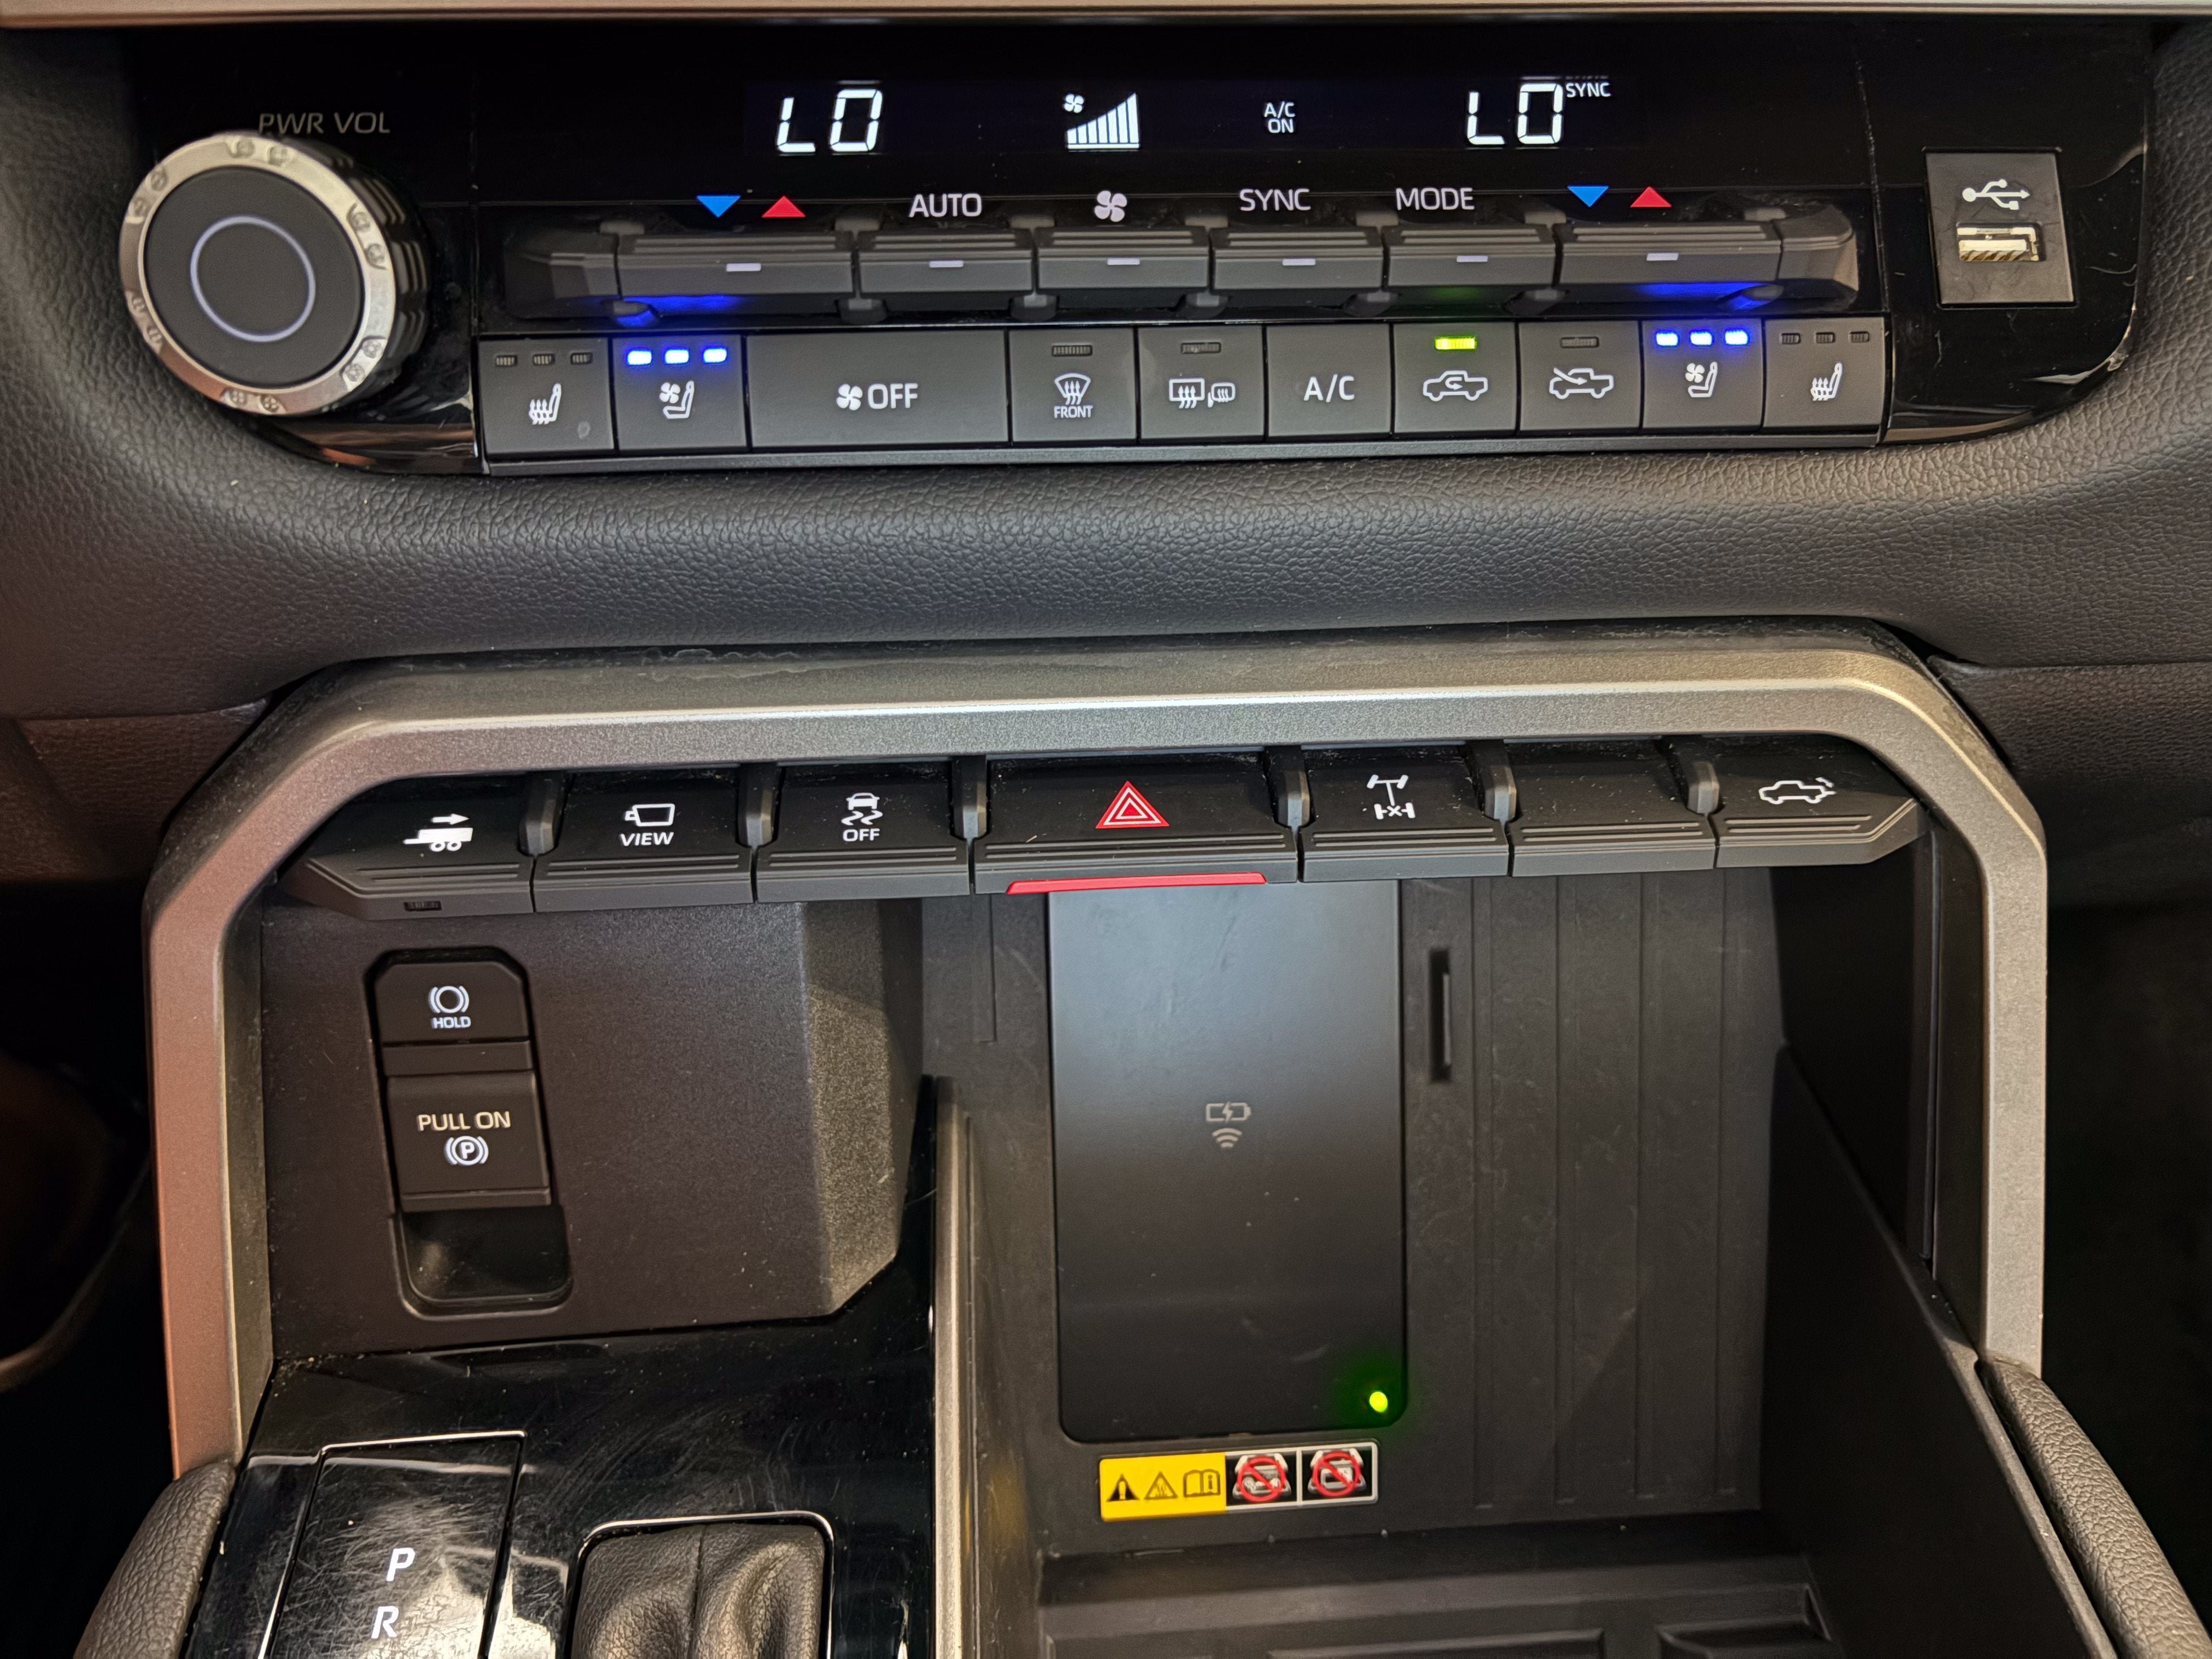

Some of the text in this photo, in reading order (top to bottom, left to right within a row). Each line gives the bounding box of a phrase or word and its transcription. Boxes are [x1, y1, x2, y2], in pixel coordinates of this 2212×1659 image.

[1566, 82, 1611, 98] SYNC
[1263, 102, 1296, 118] A/C
[258, 111, 391, 134] PWR VOL
[1267, 119, 1295, 133] ON
[909, 193, 982, 217] AUTO
[1239, 188, 1311, 211] SYNC
[1396, 188, 1475, 210] MODE
[867, 383, 918, 409] OFF
[1304, 374, 1355, 403] A/C
[1054, 405, 1092, 419] FRONT
[620, 832, 674, 847] VIEW
[842, 828, 881, 842] OFF
[432, 1017, 471, 1029] HOLD
[417, 1111, 511, 1131] PULL ON
[386, 1547, 415, 1582] P
[371, 1605, 399, 1639] R
